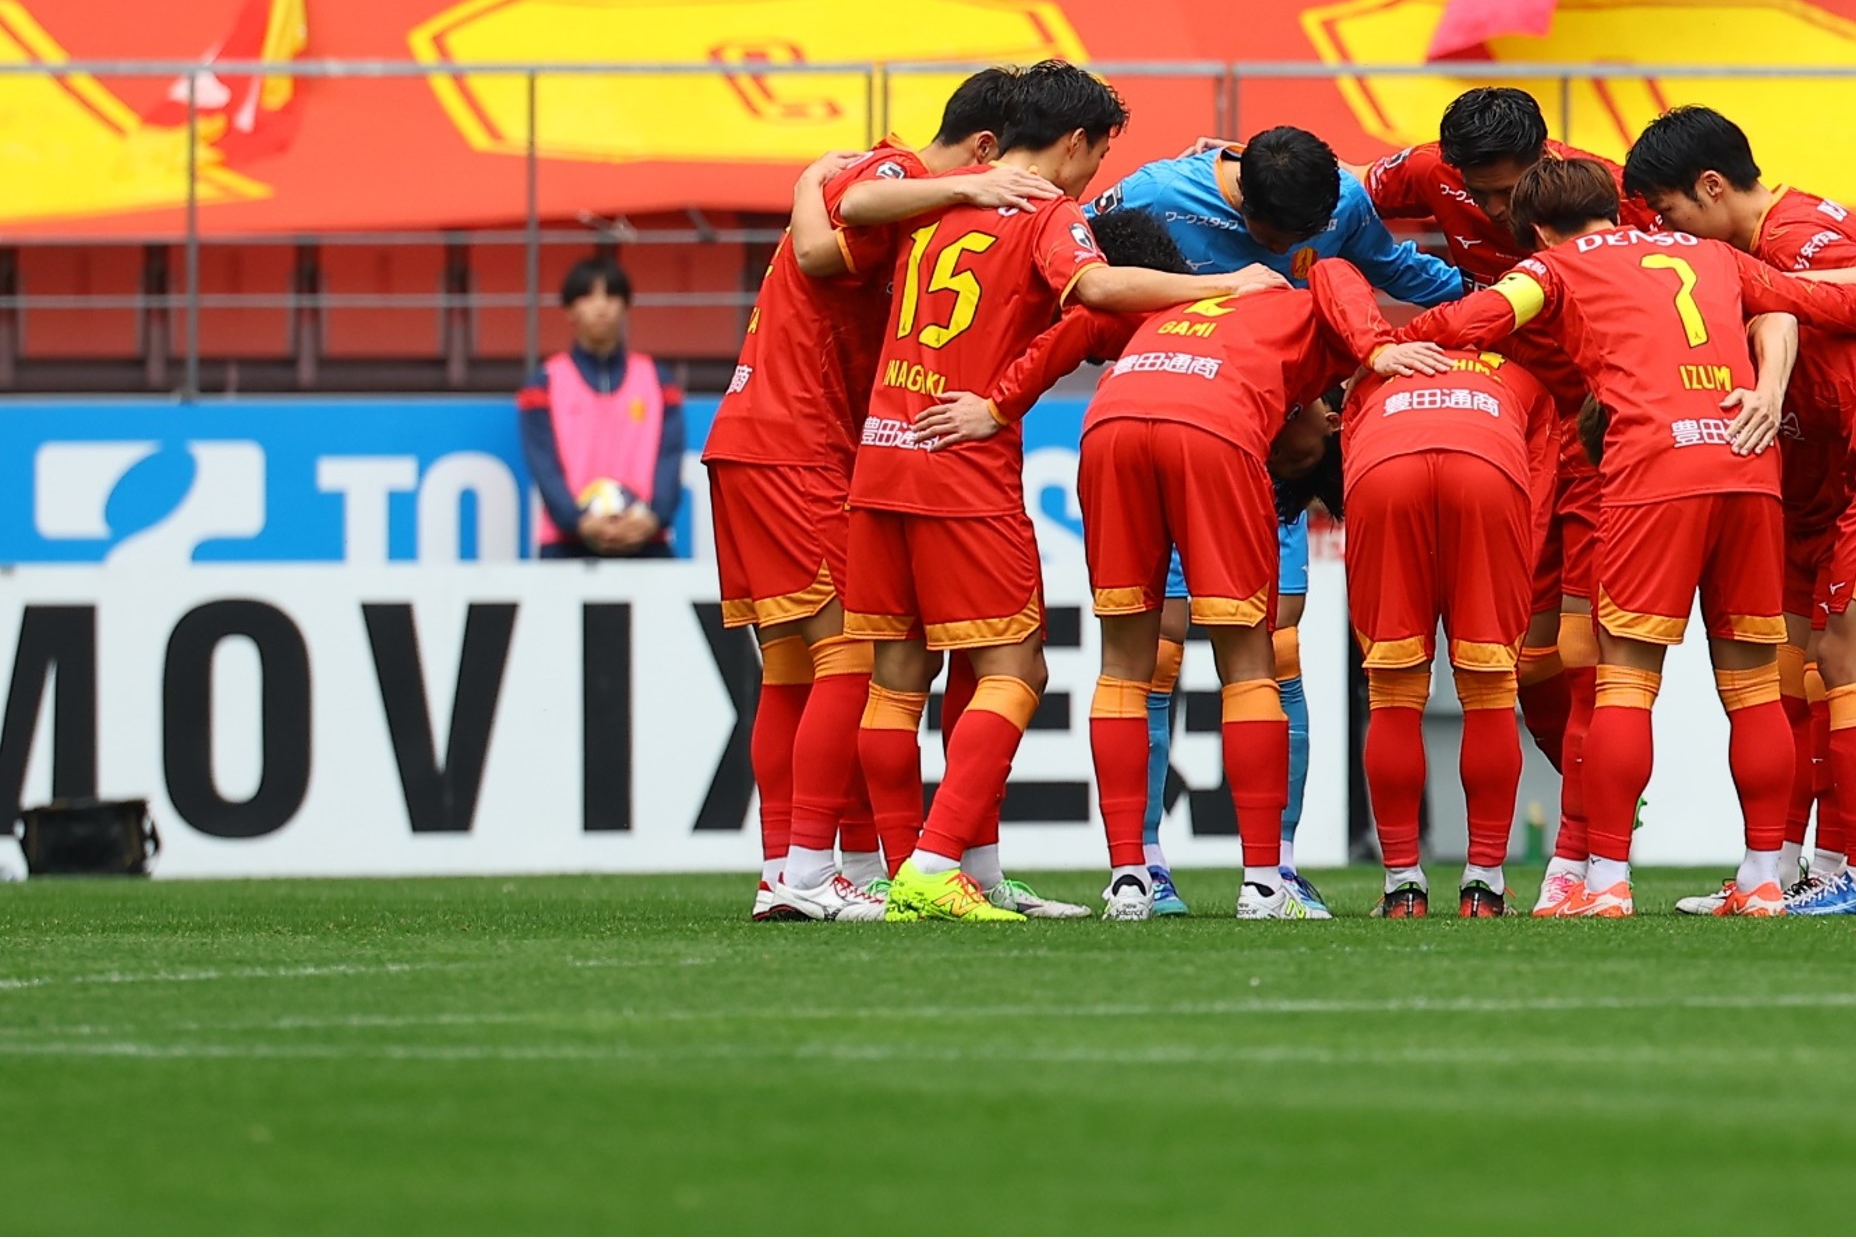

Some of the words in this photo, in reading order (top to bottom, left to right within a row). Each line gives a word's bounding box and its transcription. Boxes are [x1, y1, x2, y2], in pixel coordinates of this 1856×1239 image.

[1575, 229, 1699, 253] DENSO
[896, 220, 999, 350] 15
[1639, 252, 1709, 349] 7
[1679, 365, 1732, 392] IZUM
